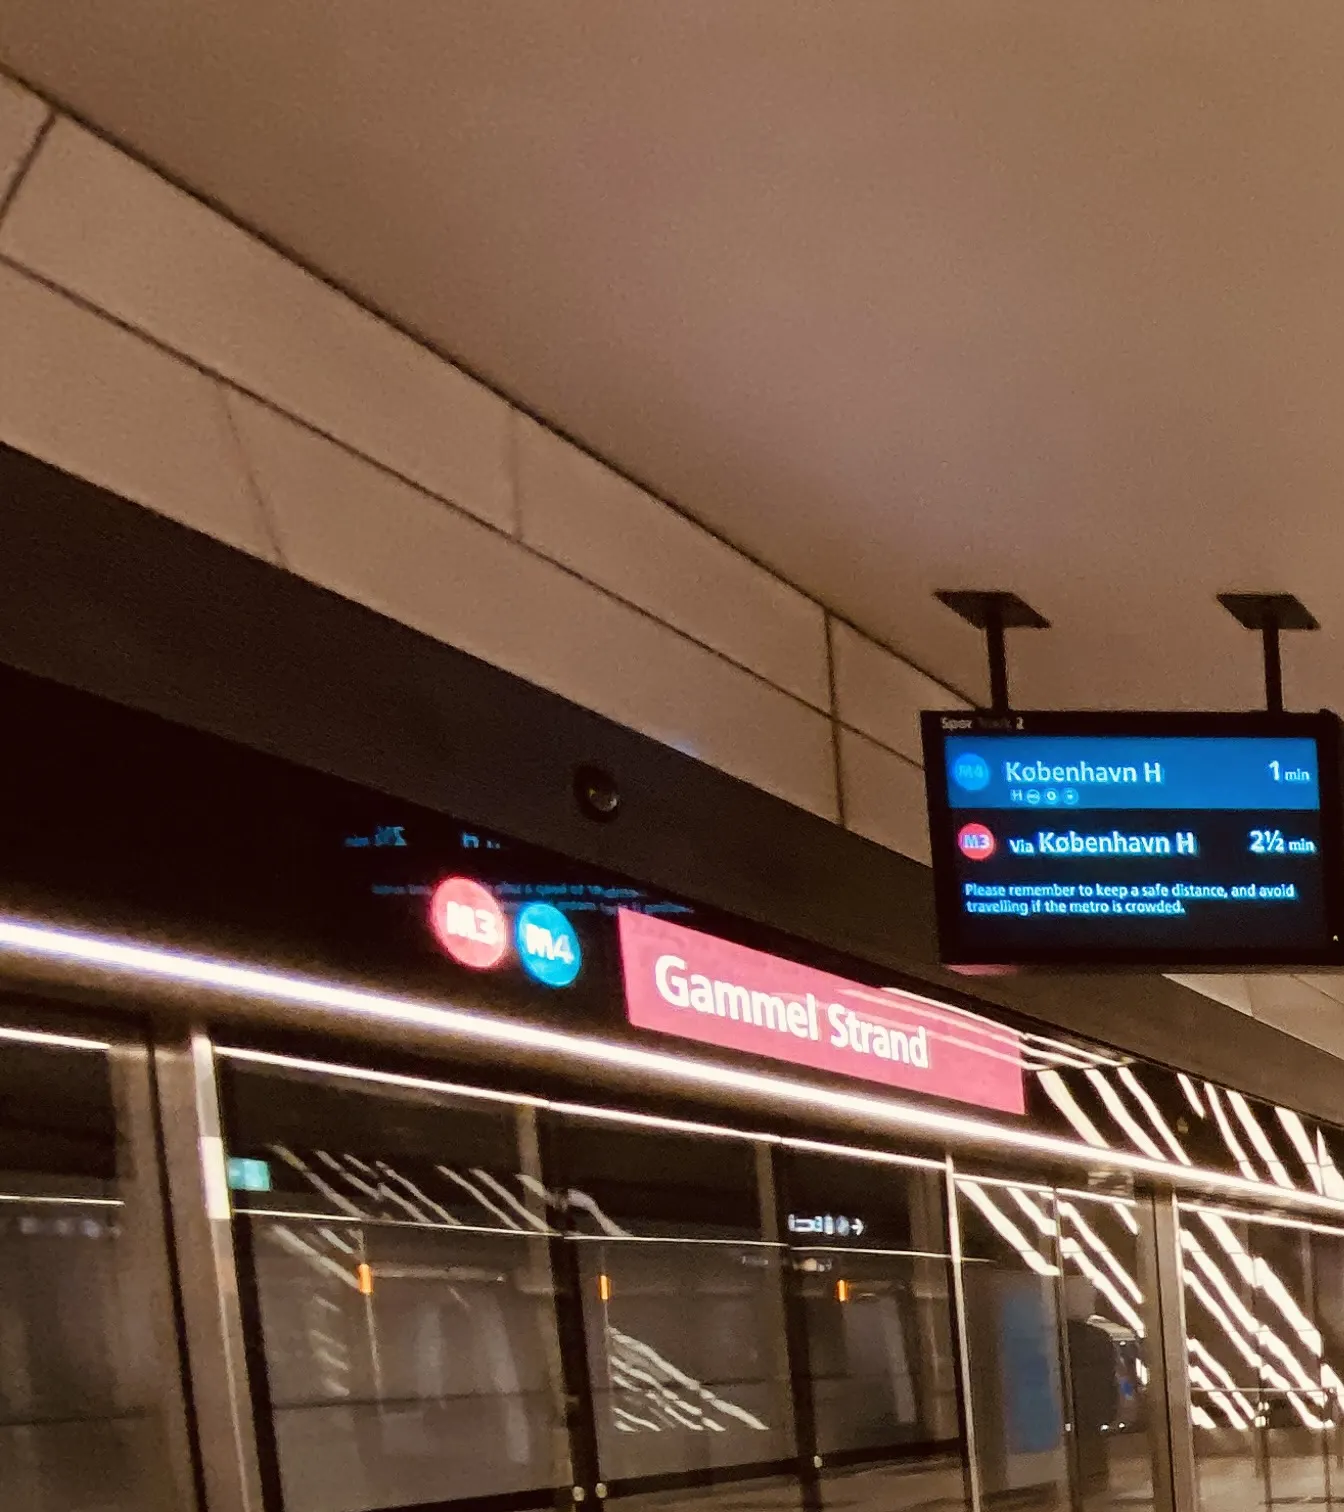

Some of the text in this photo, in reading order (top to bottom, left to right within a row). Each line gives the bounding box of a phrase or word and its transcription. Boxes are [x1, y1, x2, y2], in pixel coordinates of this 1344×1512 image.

[1006, 761, 1161, 783] København H
[1269, 760, 1310, 781] 1 min
[963, 834, 989, 848] M3
[1009, 830, 1195, 853] Via København H
[1288, 838, 1315, 852] min
[965, 883, 1295, 899] Please remember to keep a safe distance, and avoid
[966, 900, 1185, 916] travelling if the metro is crowded.
[446, 901, 498, 945] M3
[526, 923, 574, 964] M4
[655, 954, 929, 1069] Gammel Strand
